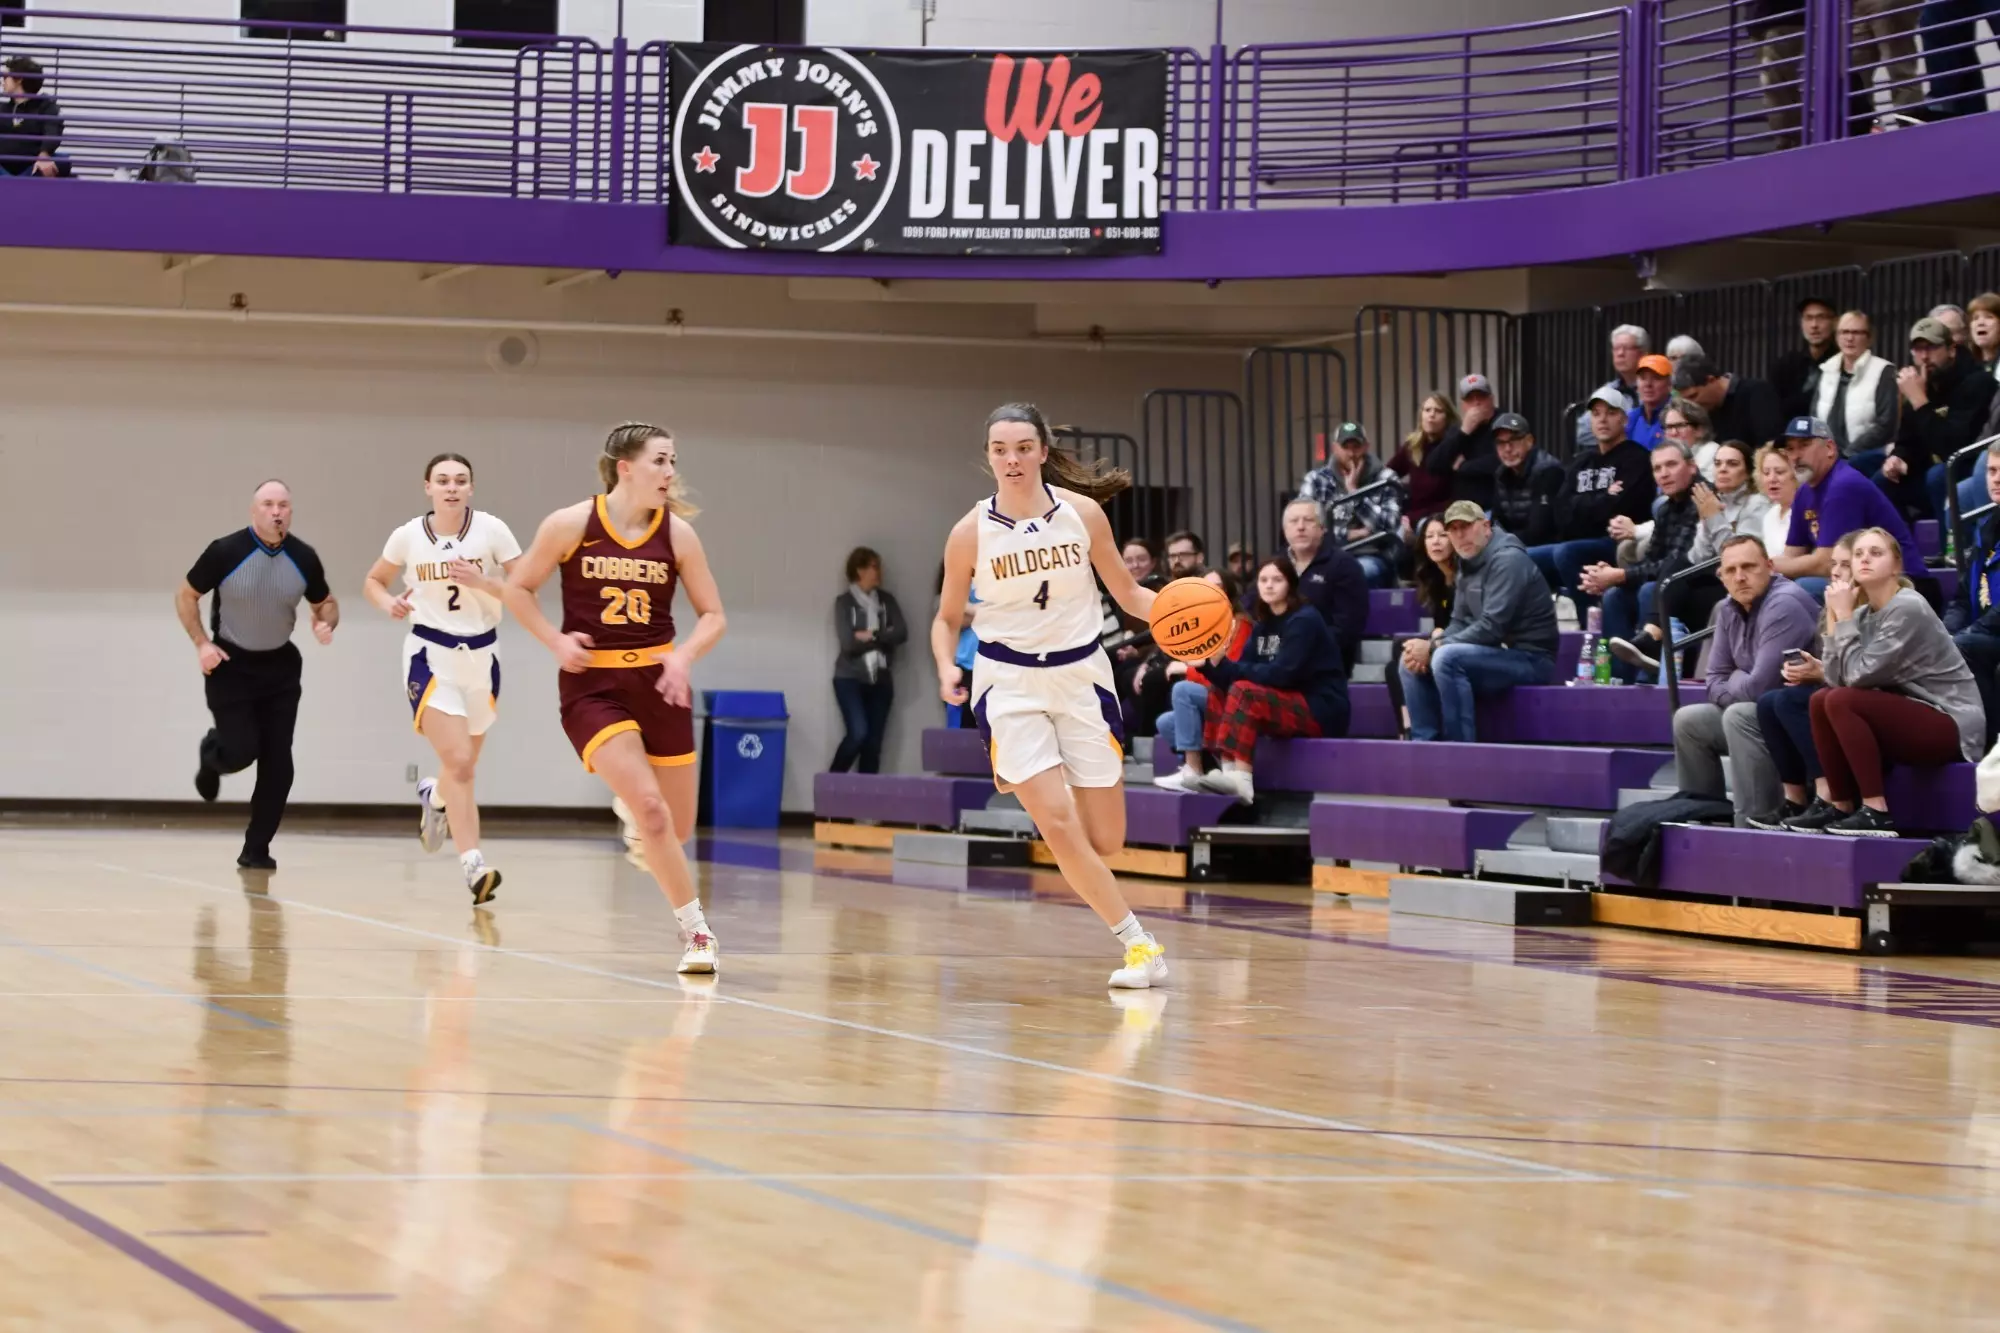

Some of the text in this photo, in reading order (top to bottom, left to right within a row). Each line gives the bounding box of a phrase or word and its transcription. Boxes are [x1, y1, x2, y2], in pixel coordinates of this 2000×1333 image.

[698, 58, 878, 138] JIMMY JOHN'S
[984, 53, 1103, 146] We
[735, 102, 839, 200] JJ
[908, 128, 1159, 220] DELIVER
[711, 193, 858, 241] SANDWICHES
[925, 226, 948, 239] FORD
[949, 227, 974, 239] PKWY
[975, 227, 1011, 239] DELIVER
[1012, 227, 1024, 239] TO
[1025, 227, 1057, 239] BUTLER
[1058, 227, 1091, 239] CENTER
[415, 558, 483, 581] WILDS
[581, 556, 669, 584] COBBERS
[990, 543, 1081, 580] WILDCATS
[447, 585, 461, 611] 2
[600, 586, 652, 625] 20
[1033, 580, 1049, 610] 4
[1170, 616, 1199, 637] EVO
[1170, 632, 1222, 656] Wilson
